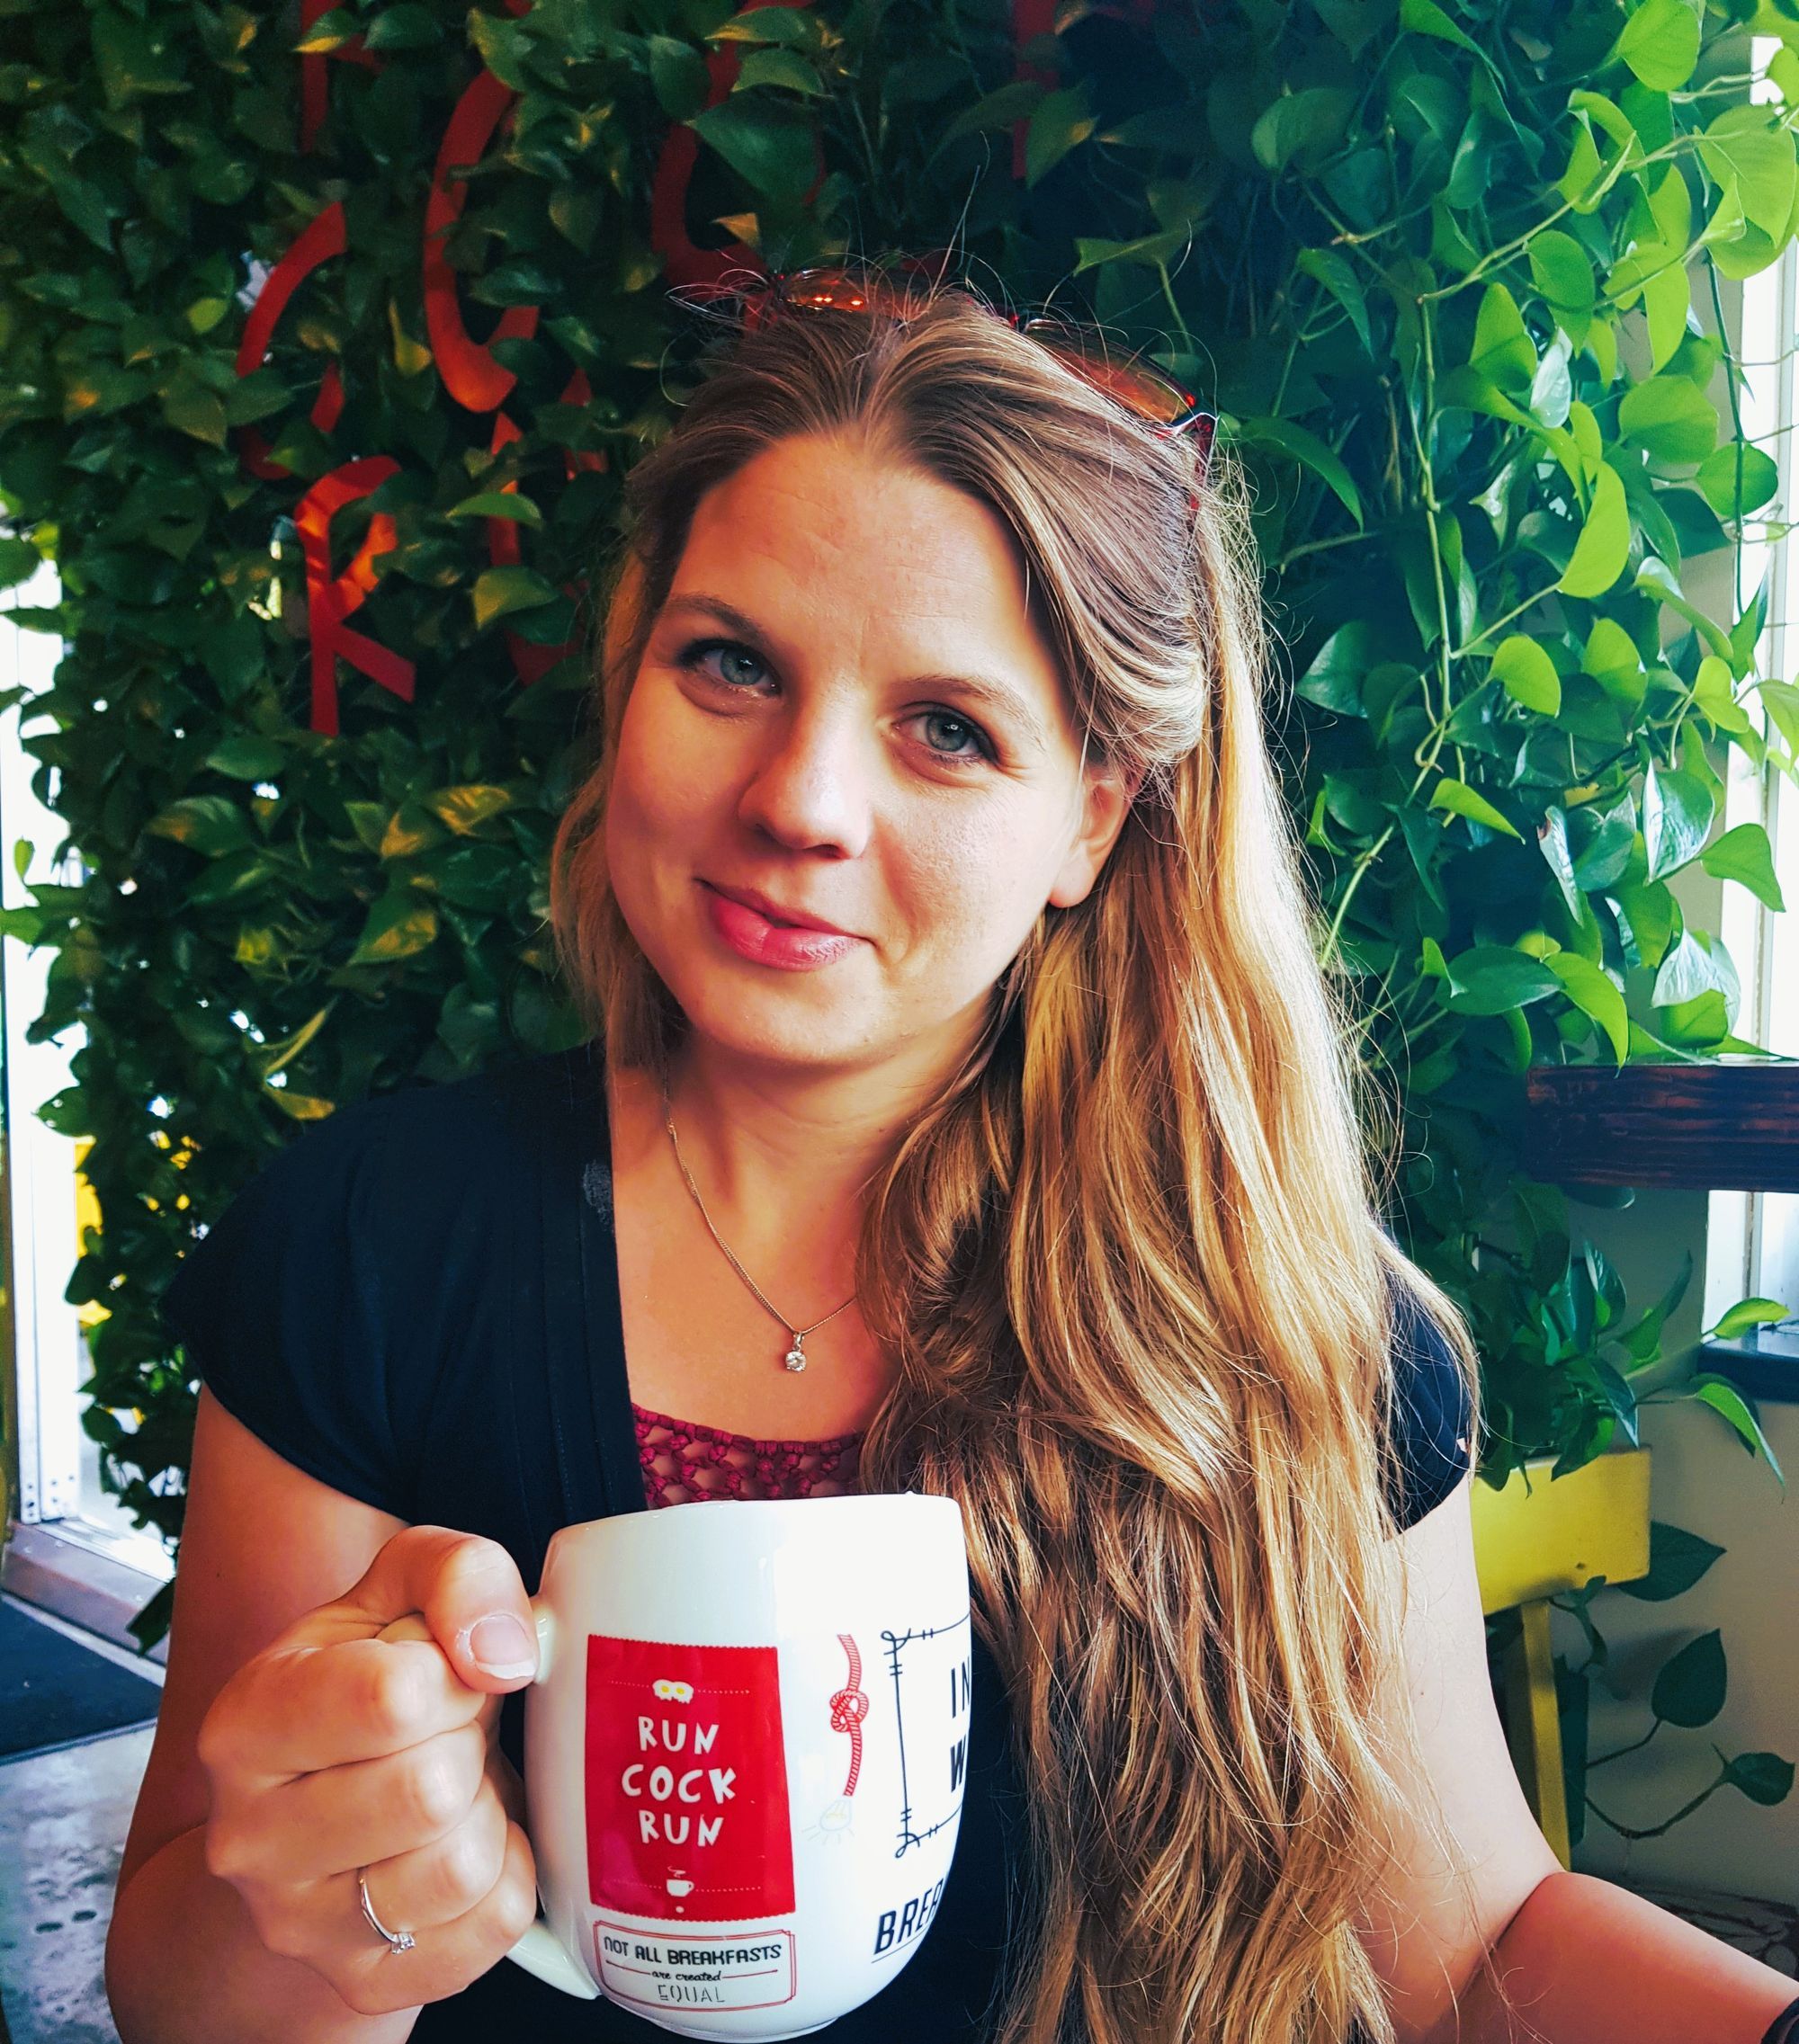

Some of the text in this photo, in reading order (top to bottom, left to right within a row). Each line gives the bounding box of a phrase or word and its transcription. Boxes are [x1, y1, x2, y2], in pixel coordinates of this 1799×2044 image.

[638, 1716, 720, 1754] RUN
[622, 1763, 737, 1805] COCK
[639, 1809, 724, 1847] RUN
[604, 1936, 782, 1965] NOT ALL BREAKFASTS
[651, 1970, 721, 1981] are created
[658, 1985, 725, 2003] EQUAL
